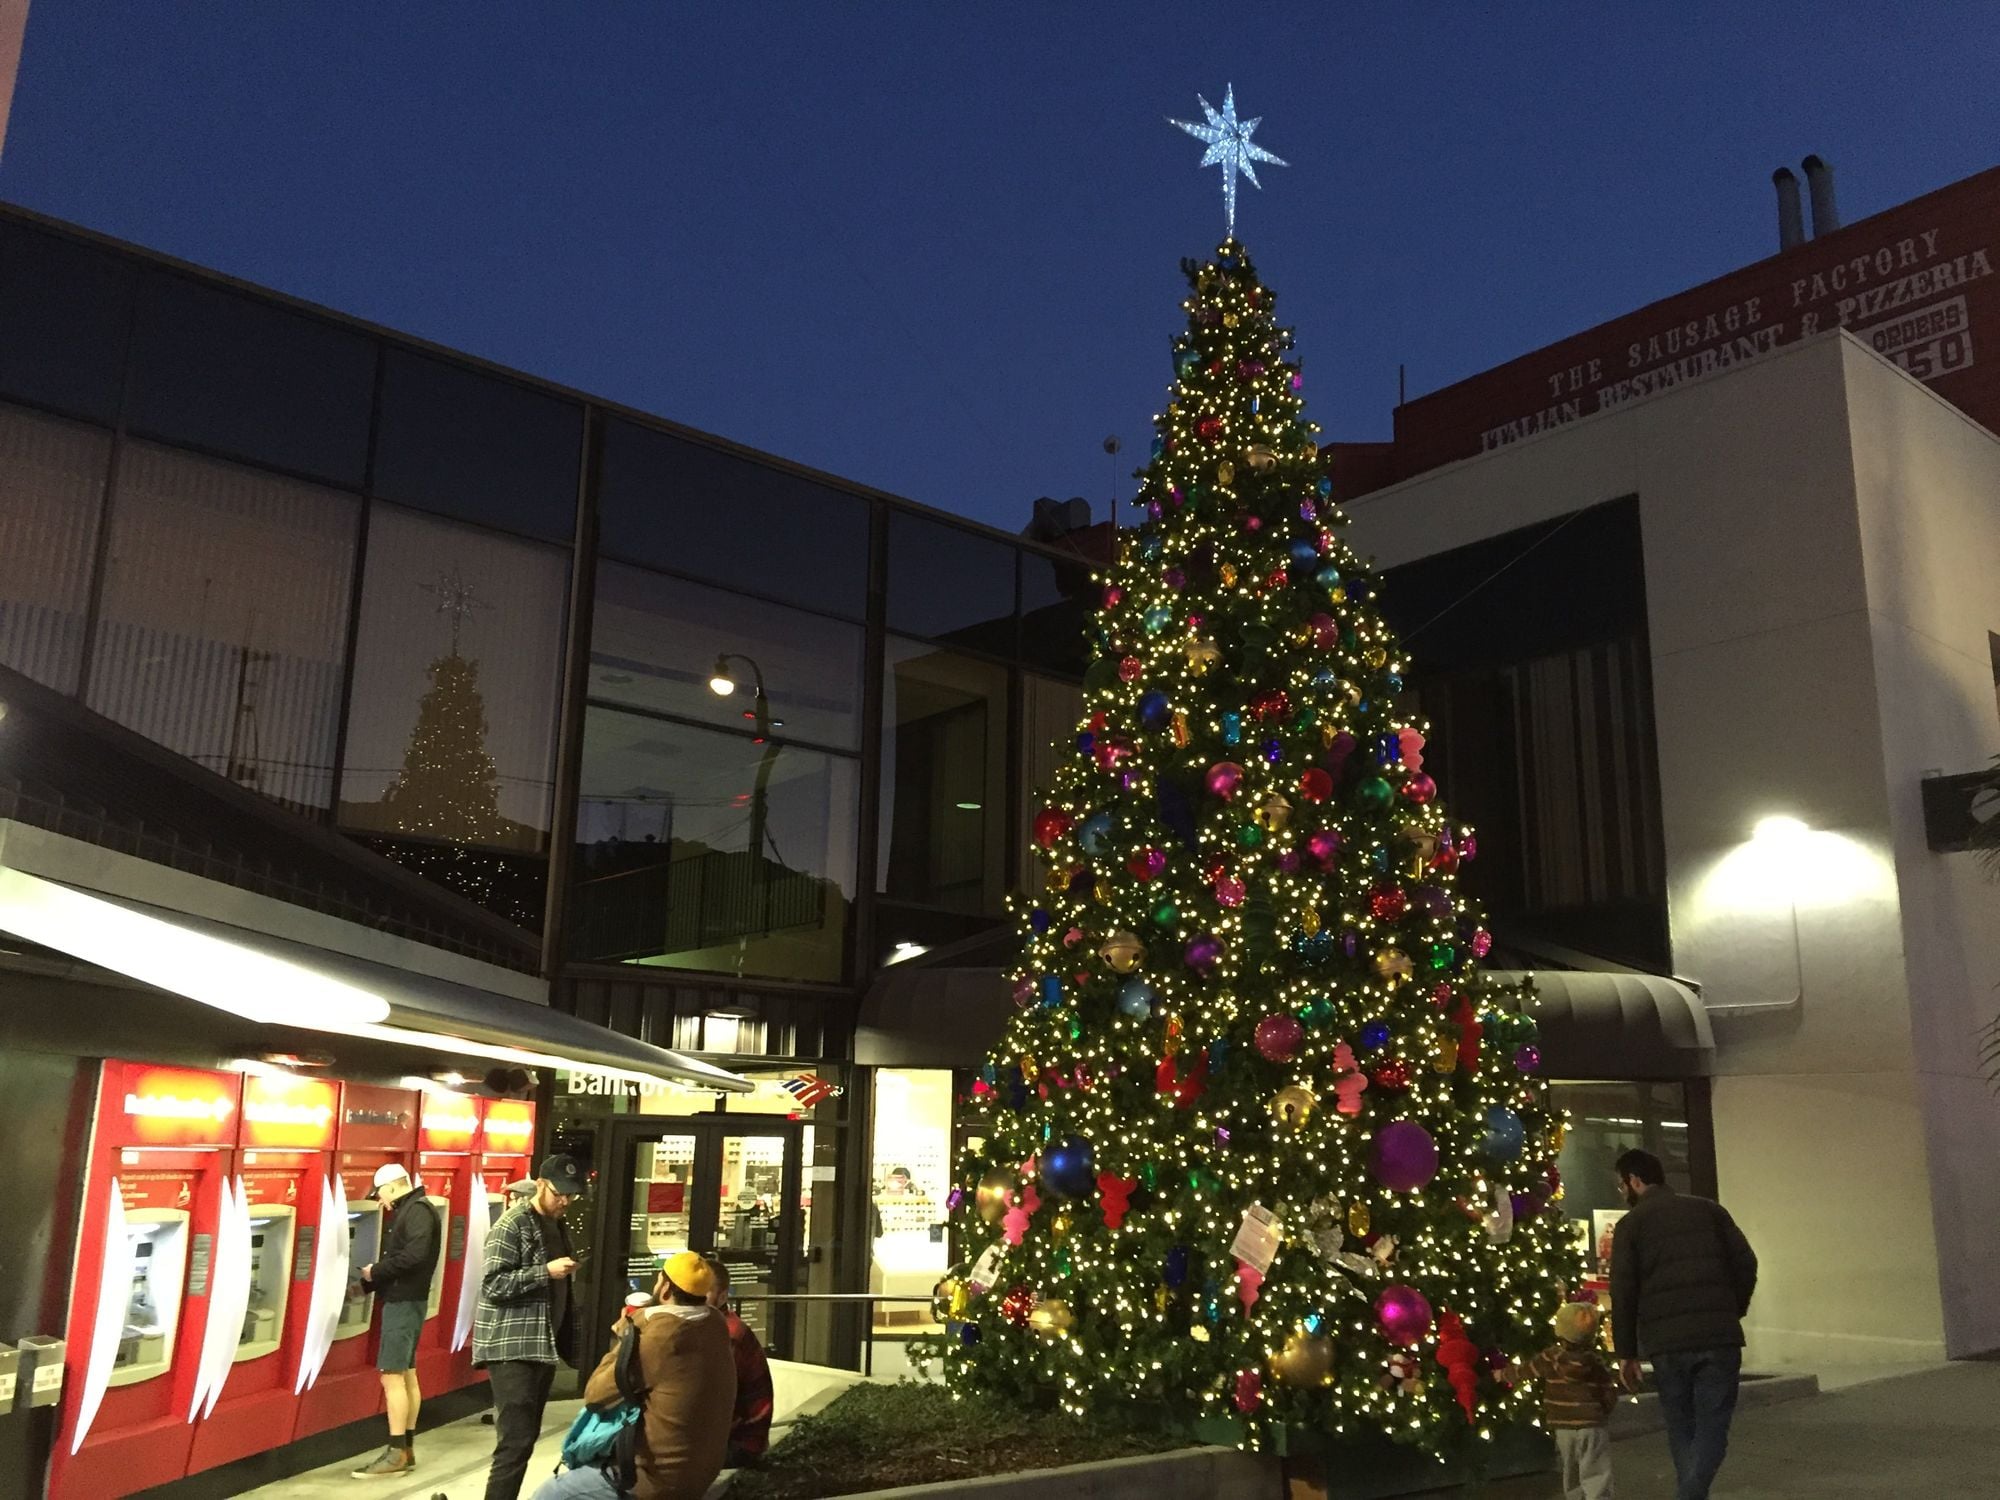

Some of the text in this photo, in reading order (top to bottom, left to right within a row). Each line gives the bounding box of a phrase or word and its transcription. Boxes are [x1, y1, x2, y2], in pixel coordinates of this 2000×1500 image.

[1481, 399, 1581, 451] ITALIAN
[1598, 323, 1784, 408] RESTAURANT
[1836, 248, 1994, 327] PIZZERIA
[1549, 228, 1939, 397] THE SAUSAGE FACTORY
[1872, 304, 1961, 351] ORDERS
